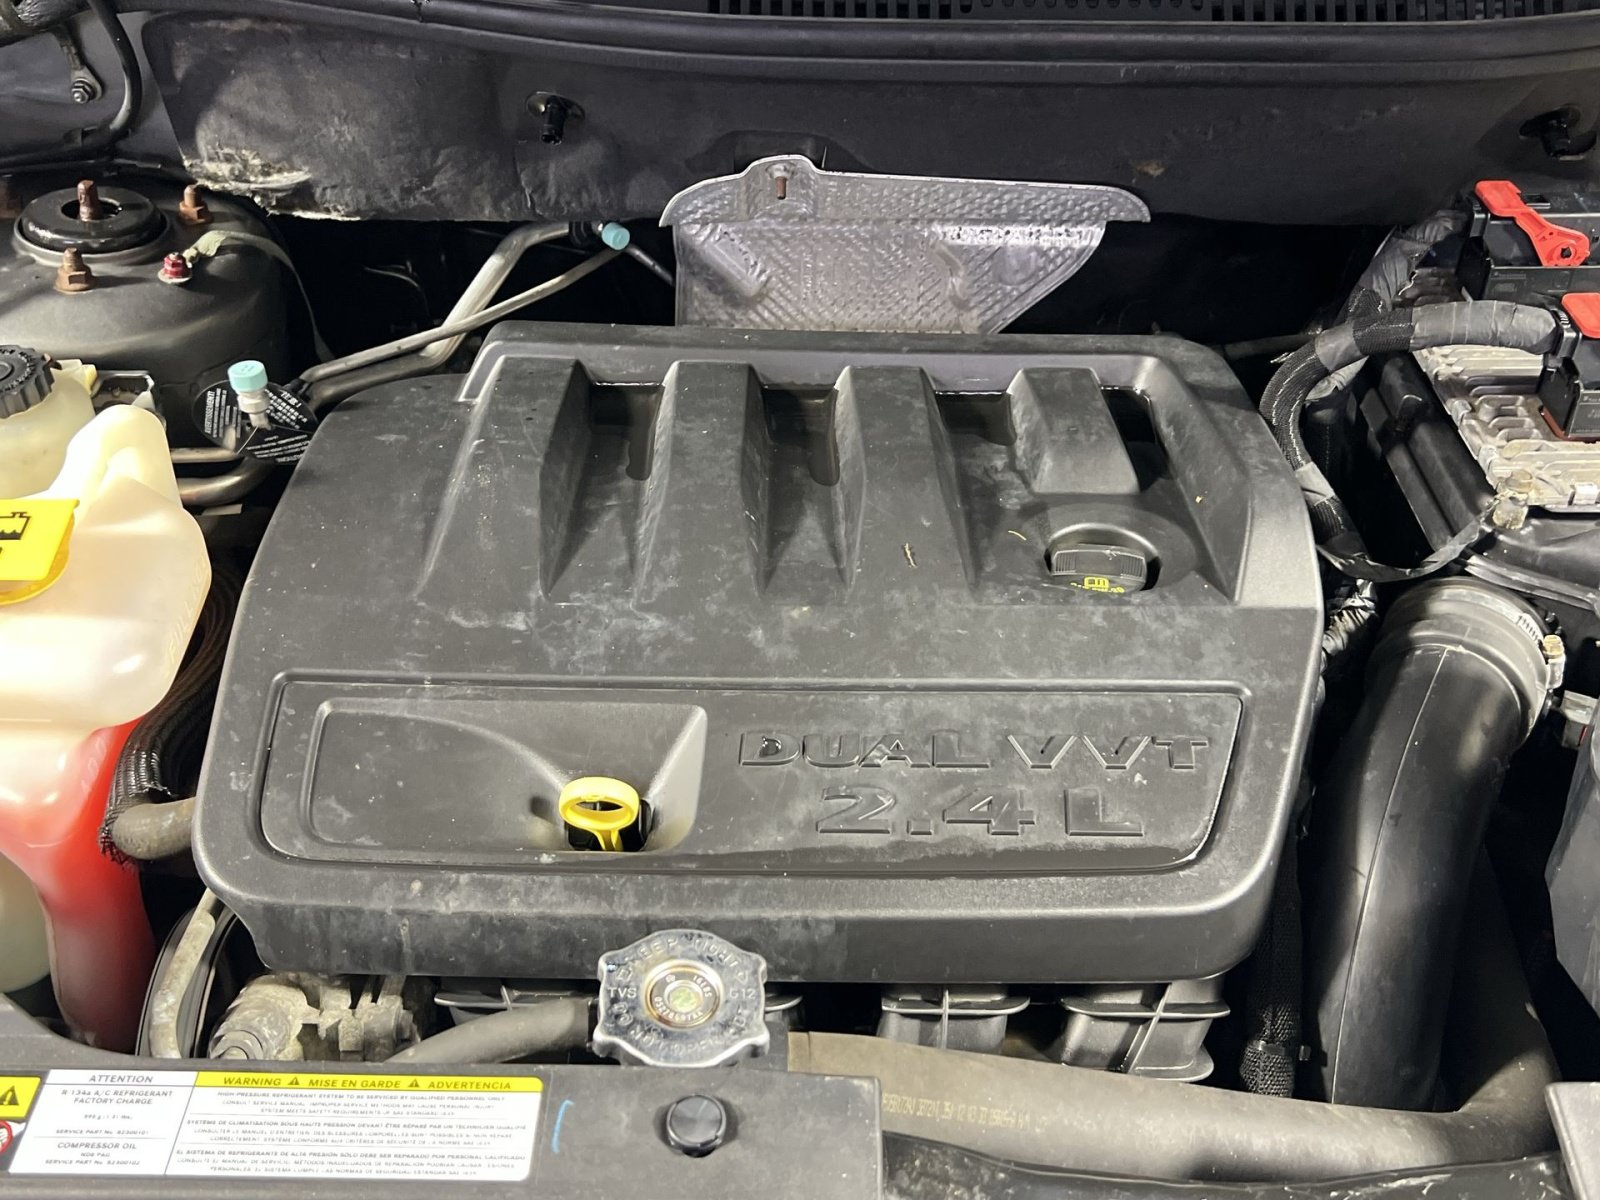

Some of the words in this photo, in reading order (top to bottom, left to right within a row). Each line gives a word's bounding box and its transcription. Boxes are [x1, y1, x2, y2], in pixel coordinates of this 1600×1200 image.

[739, 730, 990, 768] DUAL
[1007, 734, 1208, 770] VVT
[1064, 788, 1144, 837] L
[607, 986, 638, 999] TVS
[88, 1074, 154, 1083] ATTENTION
[223, 1076, 282, 1086] WARNING
[308, 1079, 338, 1087] MISE
[341, 1079, 357, 1087] EN
[360, 1080, 401, 1088] GARDE
[428, 1081, 511, 1089] ADVERTENCIA
[113, 1089, 173, 1097] REFRIGERANT
[116, 1097, 153, 1105] CHARGE
